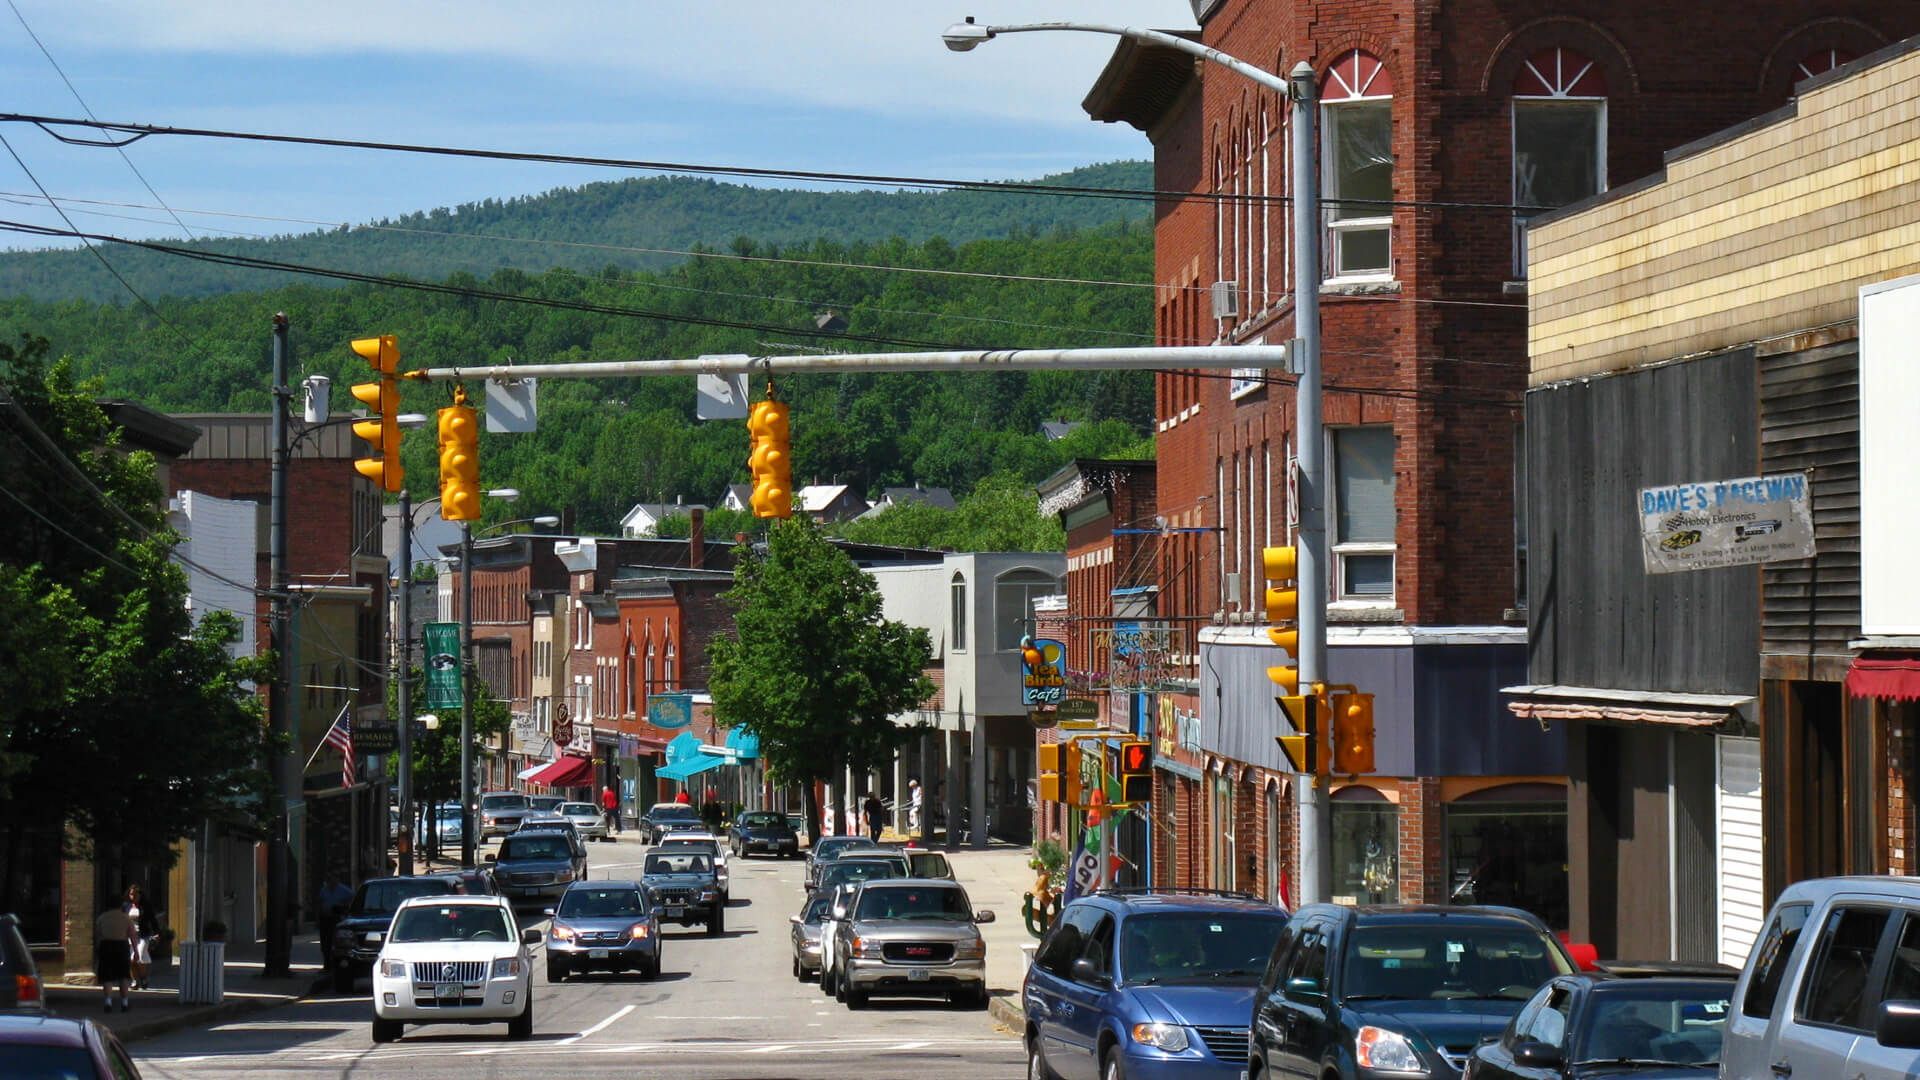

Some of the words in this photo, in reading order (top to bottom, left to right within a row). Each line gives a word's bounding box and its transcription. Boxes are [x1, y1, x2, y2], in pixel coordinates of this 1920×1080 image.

[1643, 483, 1707, 515] DAVE'S
[1714, 476, 1804, 507] RACEWAY
[1685, 515, 1710, 527] Hobby
[1713, 512, 1757, 524] Electronics
[1033, 664, 1058, 675] Tea
[1025, 674, 1065, 687] Birds
[1028, 687, 1061, 702] Café
